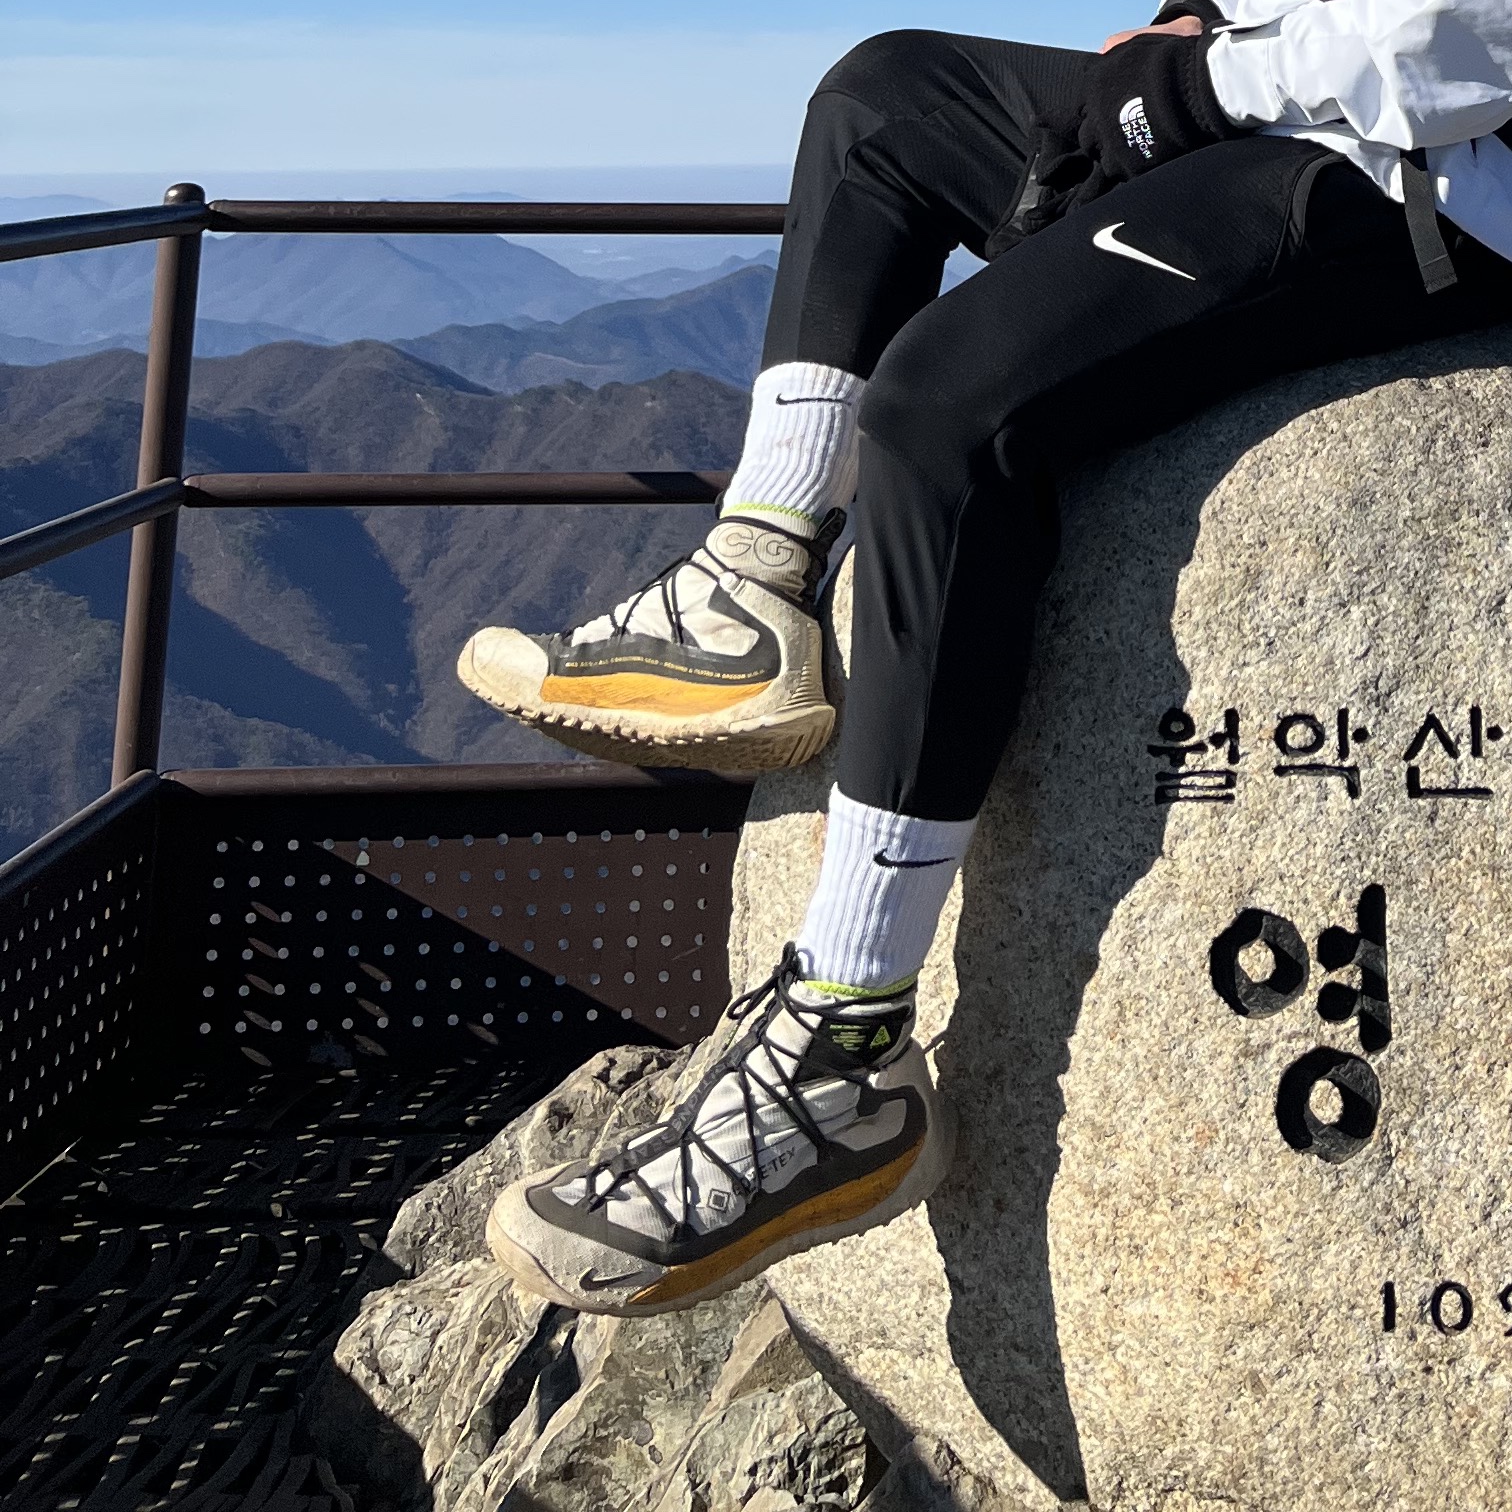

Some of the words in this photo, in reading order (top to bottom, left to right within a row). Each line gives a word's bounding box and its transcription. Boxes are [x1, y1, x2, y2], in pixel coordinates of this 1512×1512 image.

[1122, 123, 1135, 148] THE
[1132, 119, 1153, 159] NORTH
[1138, 116, 1155, 146] FACE
[1147, 706, 1503, 803] 월악산
